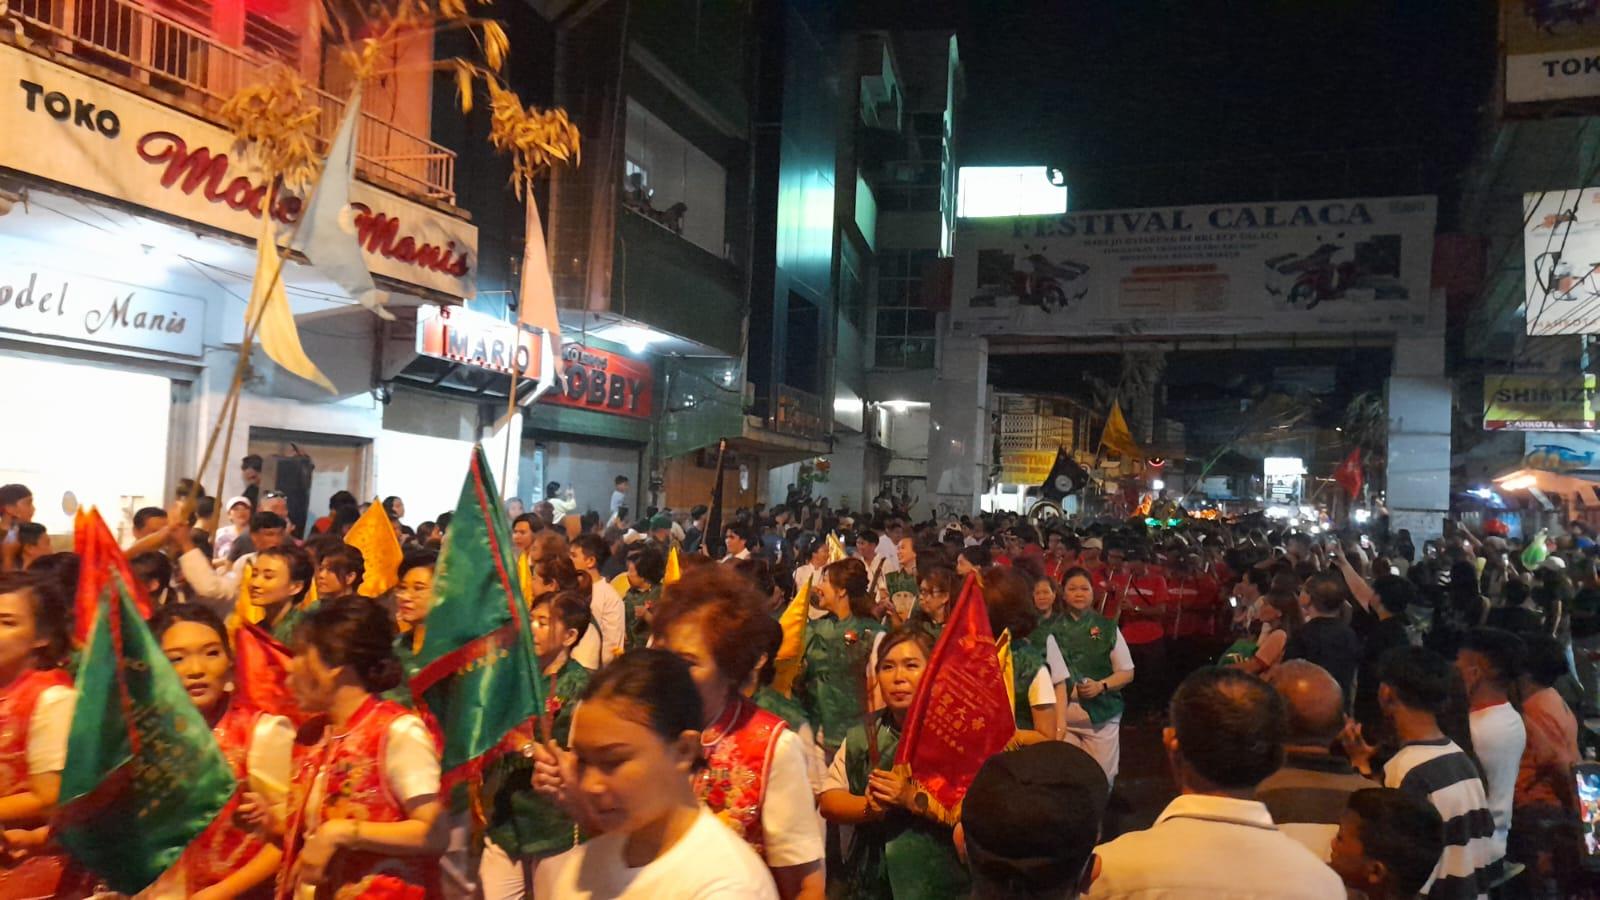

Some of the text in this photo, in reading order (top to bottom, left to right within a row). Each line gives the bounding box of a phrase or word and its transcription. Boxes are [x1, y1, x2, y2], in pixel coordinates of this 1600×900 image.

[19, 79, 120, 139] TOKO
[350, 202, 469, 277] Manis
[1013, 209, 1192, 238] FESTIVAL
[1208, 203, 1374, 230] CALACA
[85, 291, 187, 334] Manis
[449, 330, 529, 374] MARIO
